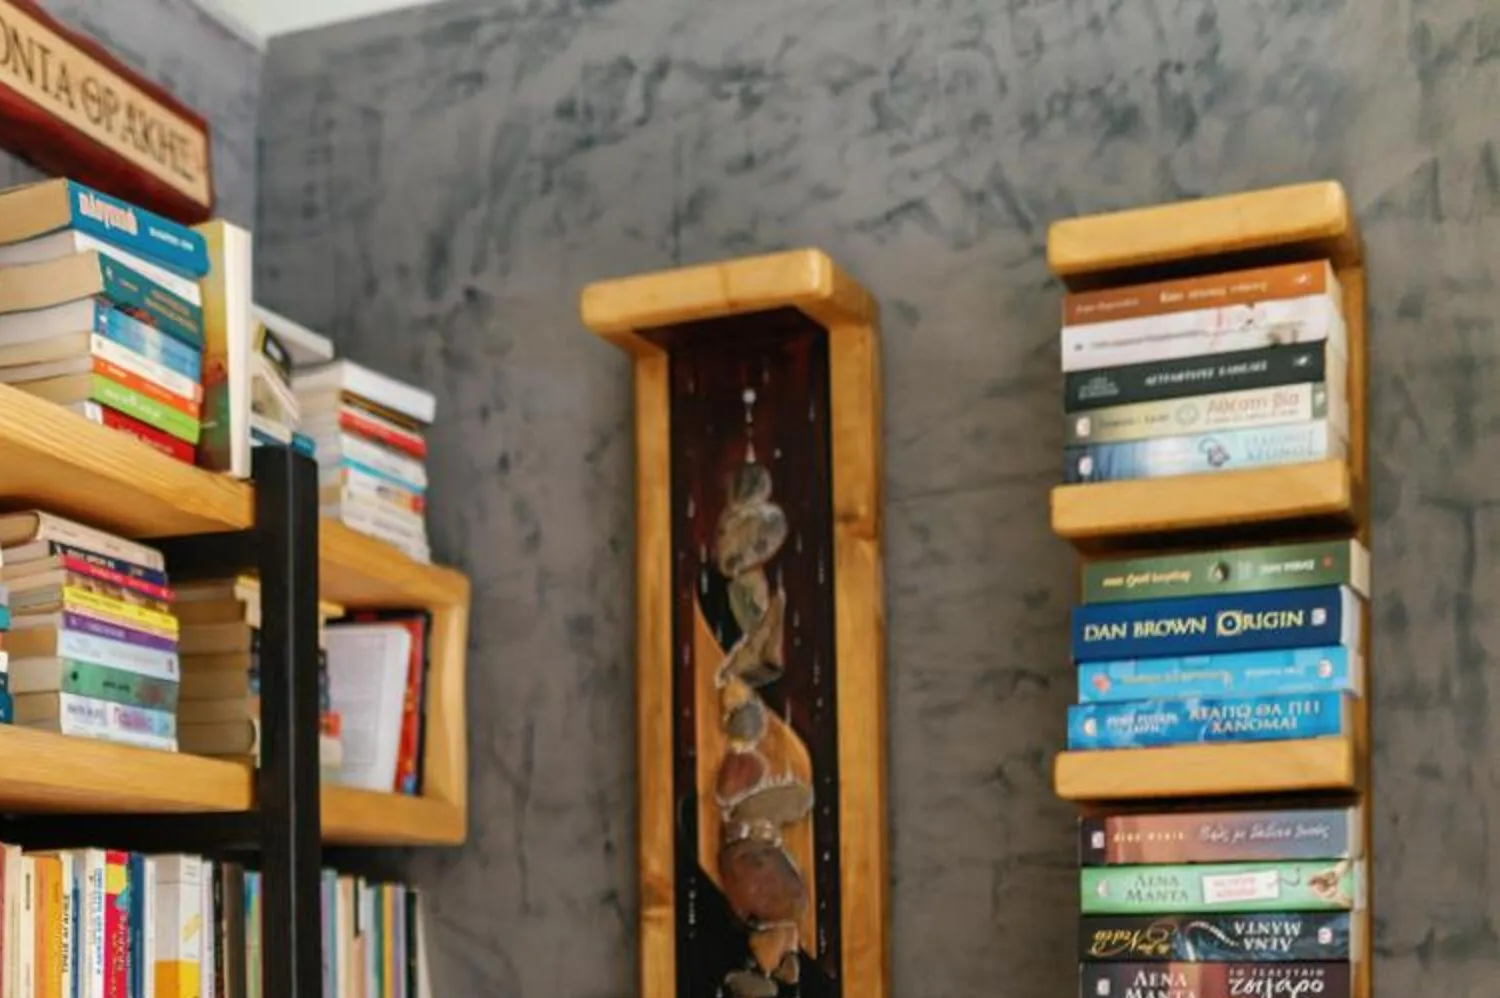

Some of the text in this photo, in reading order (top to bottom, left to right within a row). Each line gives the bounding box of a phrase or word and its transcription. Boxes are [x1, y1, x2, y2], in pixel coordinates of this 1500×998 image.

[1084, 610, 1304, 642] DAN BROWN ORIGIN
[1233, 920, 1303, 938] ΜΑΝΤΑ
[1133, 971, 1188, 988] ΛΕΝΑ
